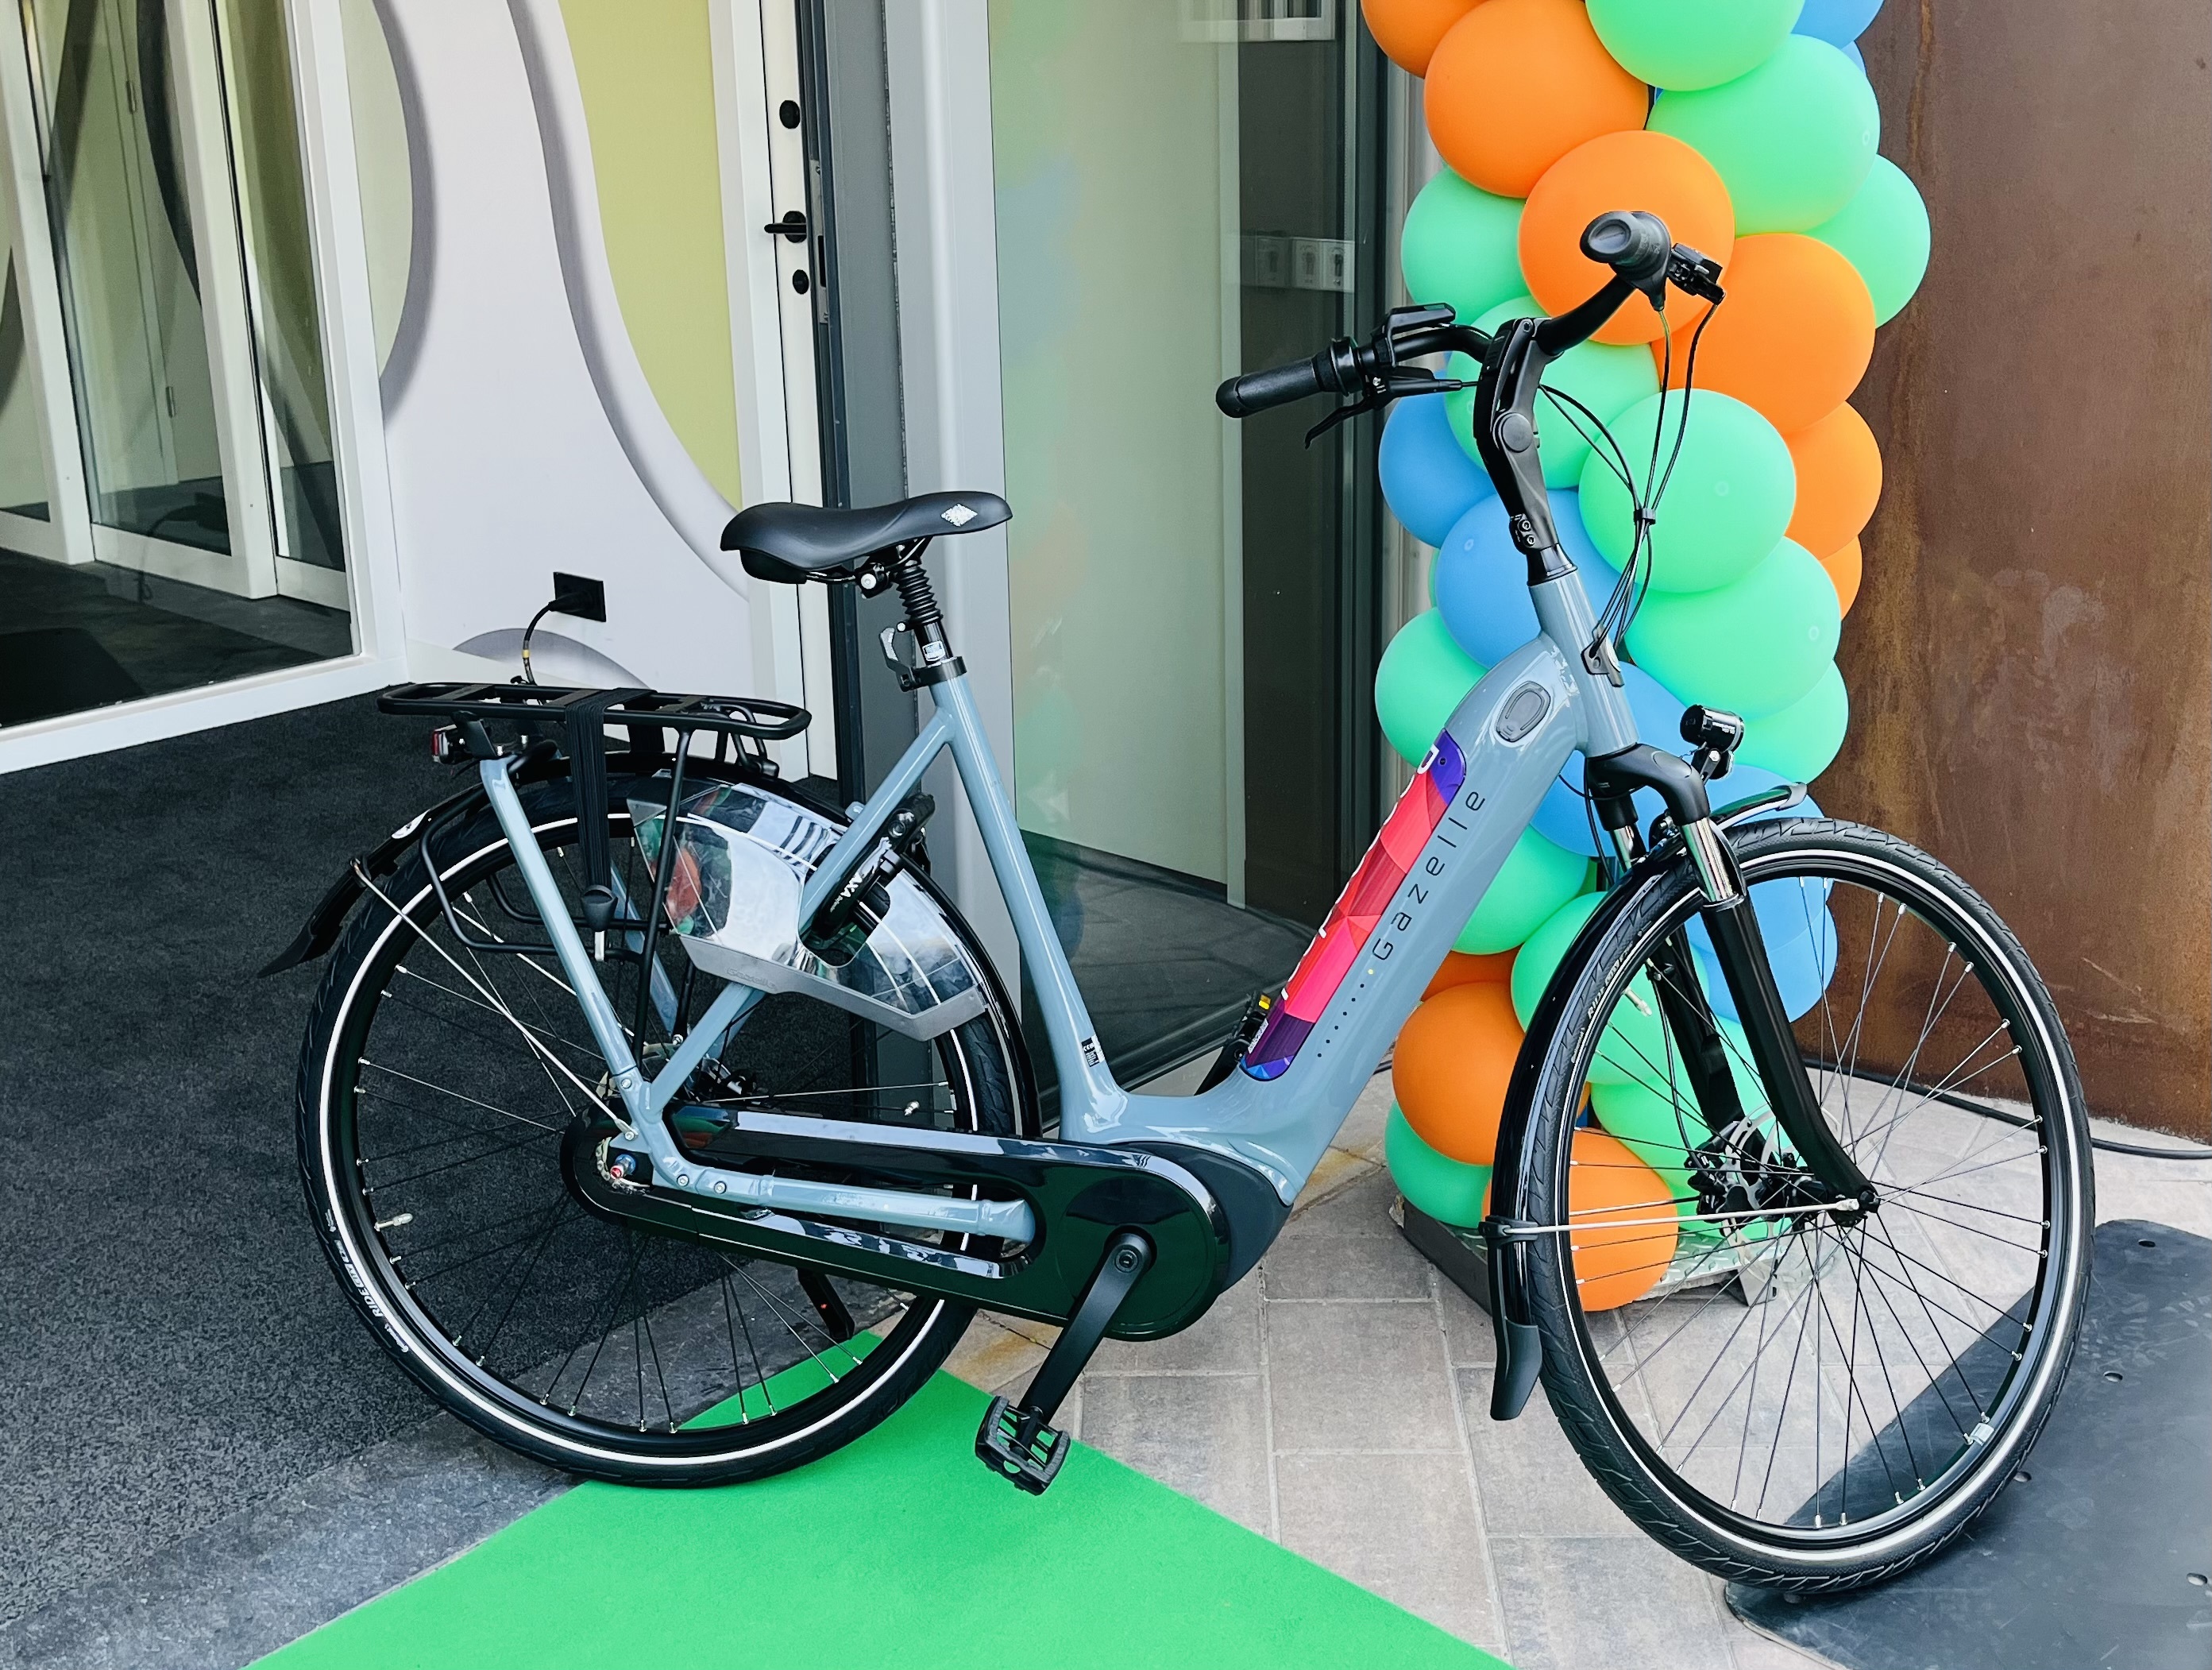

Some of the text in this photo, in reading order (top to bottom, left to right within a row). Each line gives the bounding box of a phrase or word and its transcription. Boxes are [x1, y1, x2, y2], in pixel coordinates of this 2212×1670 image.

[840, 872, 863, 898] AXA
[1372, 791, 1486, 961] Gazelle
[358, 1286, 385, 1317] RIDE
